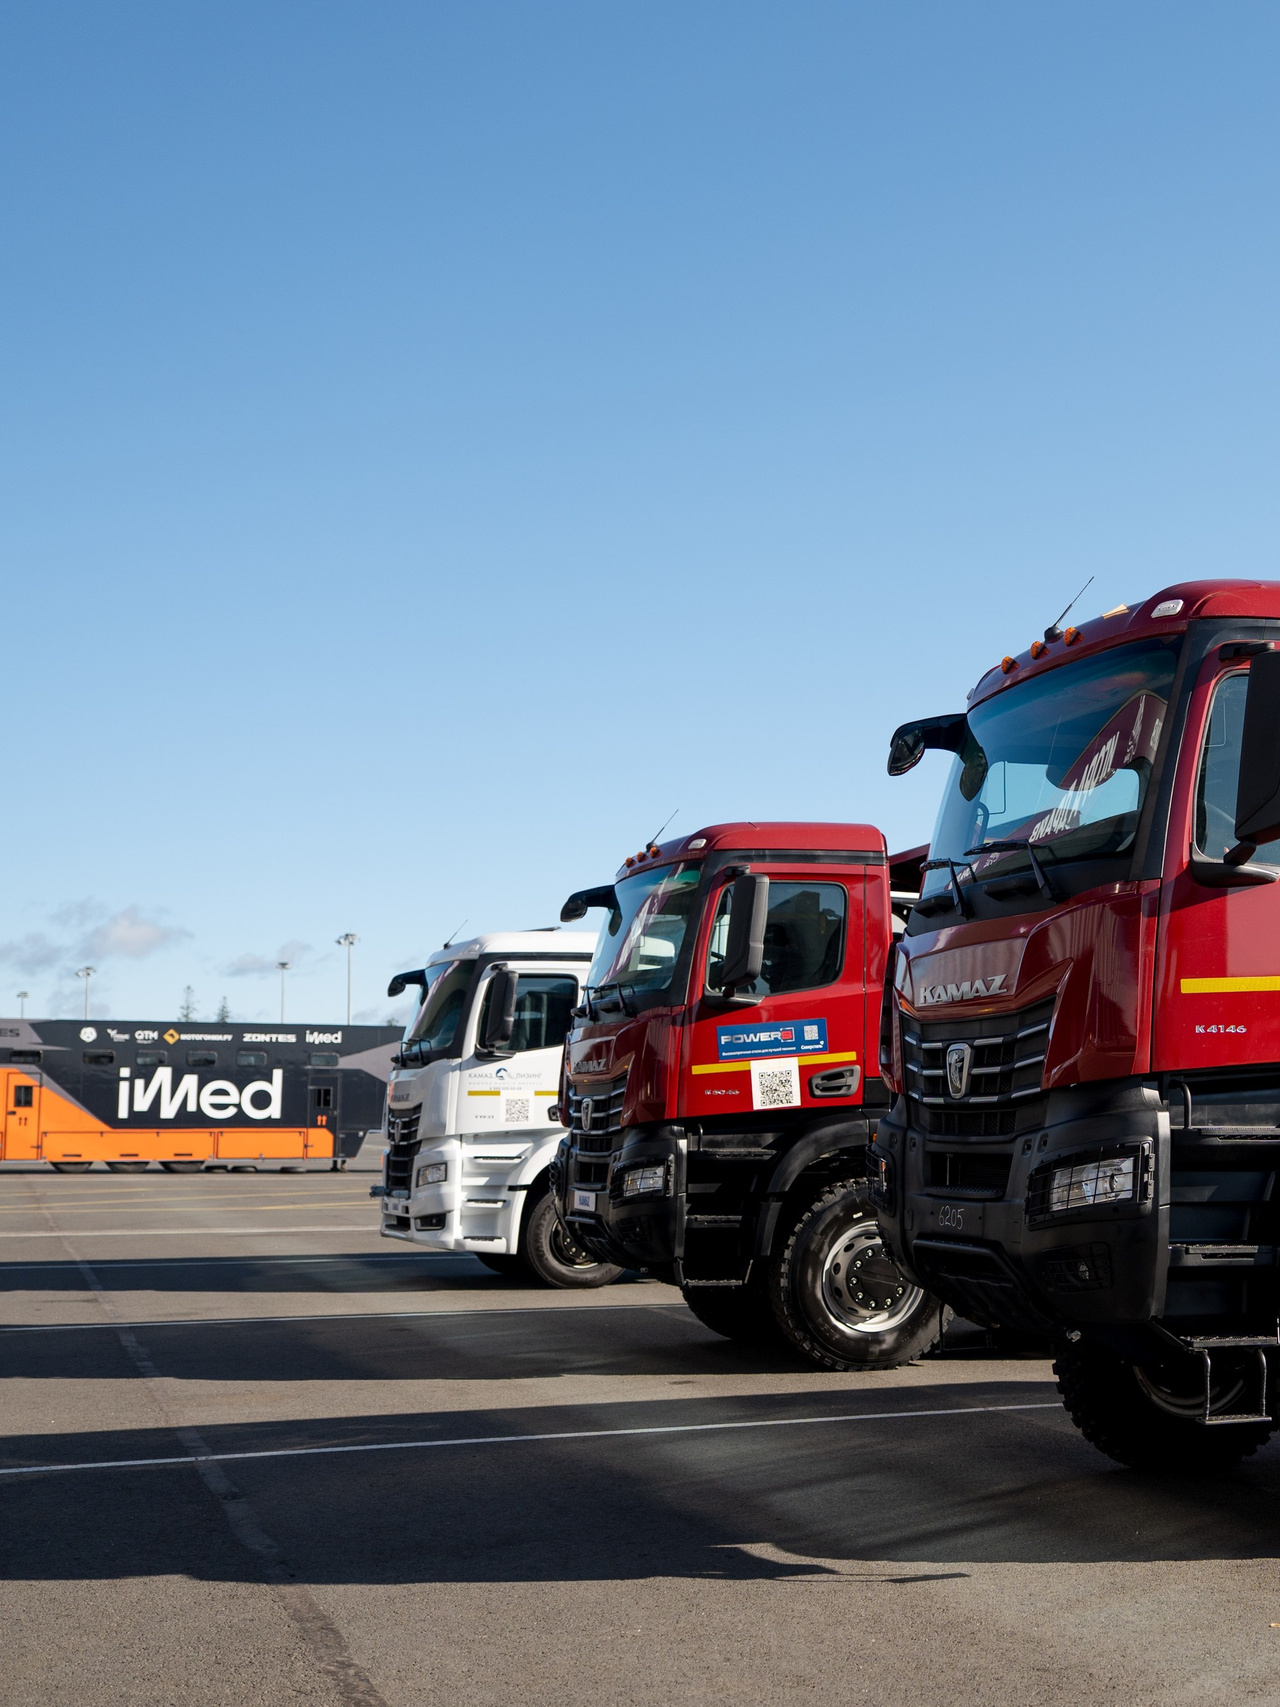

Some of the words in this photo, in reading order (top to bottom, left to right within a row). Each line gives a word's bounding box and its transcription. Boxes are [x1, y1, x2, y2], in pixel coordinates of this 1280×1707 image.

[920, 973, 1007, 1005] KAMAZ
[242, 1033, 297, 1043] ZONTES
[938, 1205, 965, 1230] 6205
